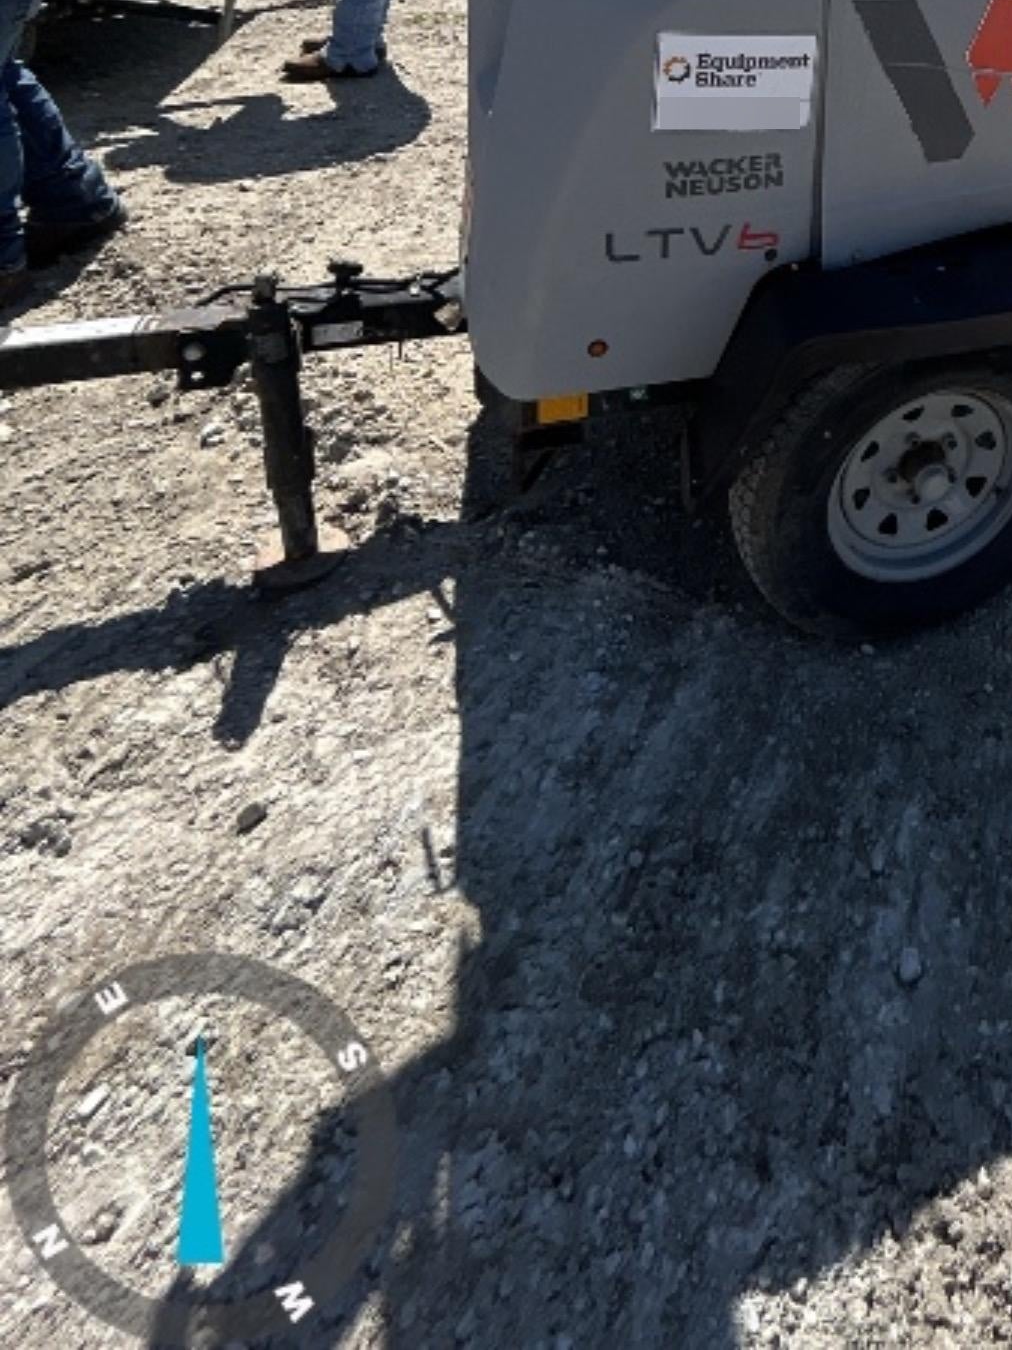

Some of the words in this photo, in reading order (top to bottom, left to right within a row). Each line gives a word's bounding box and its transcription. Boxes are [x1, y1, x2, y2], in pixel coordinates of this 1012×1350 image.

[694, 52, 811, 73] Equipment
[694, 71, 758, 88] Share
[662, 152, 783, 179] WACKER
[664, 170, 784, 199] NEUSON
